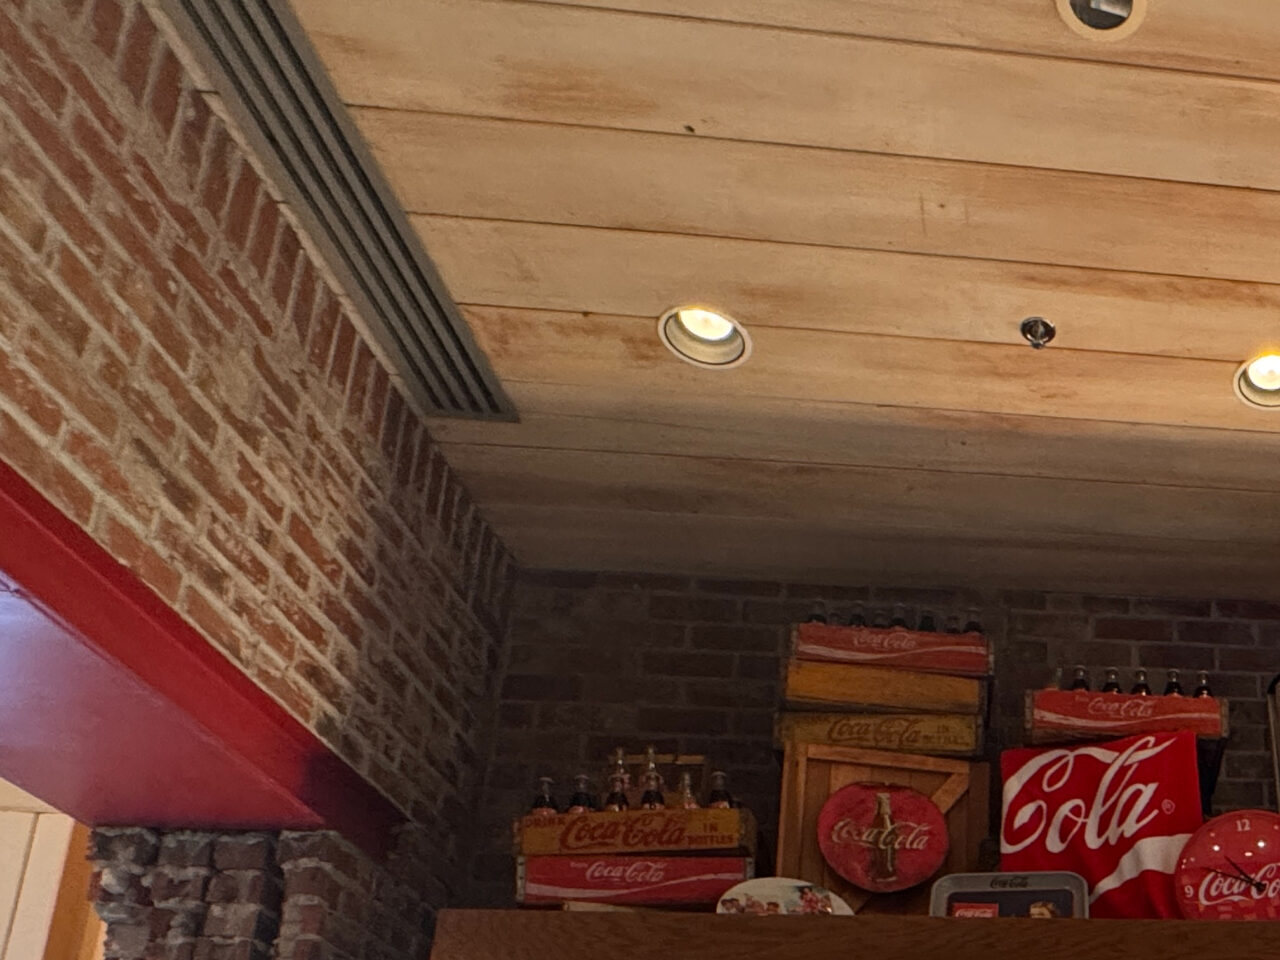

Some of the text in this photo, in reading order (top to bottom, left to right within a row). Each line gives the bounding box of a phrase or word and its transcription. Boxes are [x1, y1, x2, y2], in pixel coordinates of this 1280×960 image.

[1001, 736, 1177, 854] Cola
[702, 822, 718, 833] IN
[1236, 818, 1251, 832] 12
[687, 834, 734, 846] BOTTLES
[1183, 884, 1195, 899] 9
